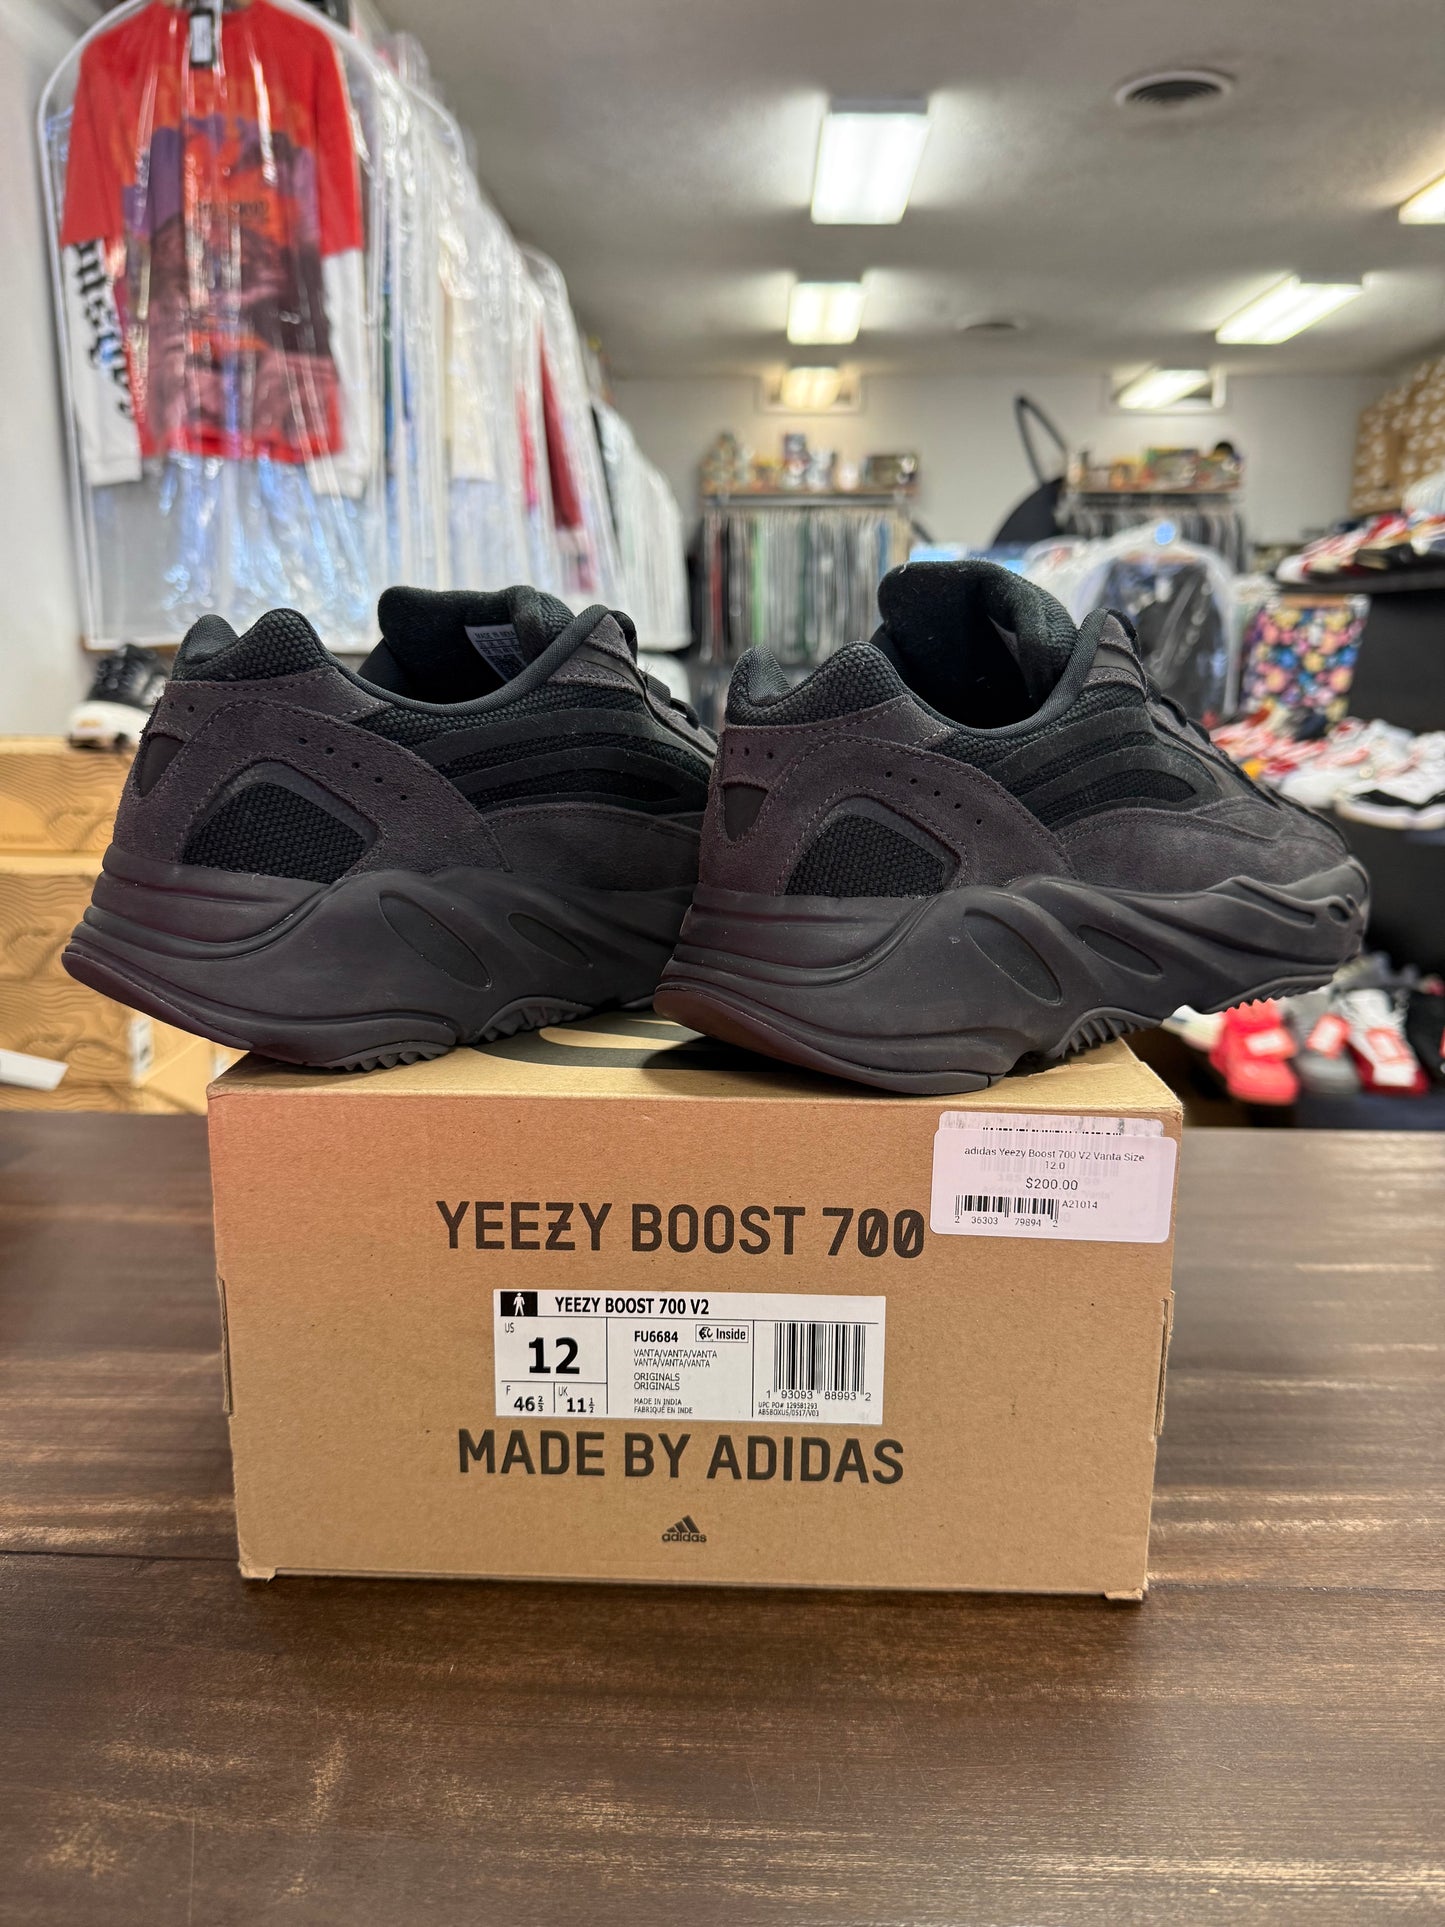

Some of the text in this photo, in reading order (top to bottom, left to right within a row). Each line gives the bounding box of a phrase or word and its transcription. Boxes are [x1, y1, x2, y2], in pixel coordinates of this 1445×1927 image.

[965, 1147, 1145, 1162] adidas Yeezy Boost 700 V2 Vanta Size
[1046, 1161, 1065, 1170] 12.0
[1026, 1177, 1079, 1191] $200.00
[1062, 1200, 1098, 1209] A21014
[955, 1216, 1058, 1228] 2 36303 79894 2
[632, 1203, 805, 1255] BOOST
[823, 1207, 925, 1259] 700
[555, 1296, 709, 1315] YEEZY BOOST 700 V2
[505, 1322, 515, 1334] US
[716, 1327, 746, 1341] Inside
[634, 1330, 679, 1343] FU6684
[528, 1336, 580, 1374] 12
[634, 1348, 717, 1359] VANTA/VANTA/VANTA
[634, 1358, 710, 1368] VANTA/VANTA/VANTA
[634, 1373, 680, 1382] ORIGINALS
[506, 1385, 511, 1396] F
[558, 1386, 569, 1397] UK
[634, 1382, 680, 1391] ORIGINALS
[634, 1398, 682, 1406] MADE IN INDIA
[765, 1390, 871, 1402] 1 93093 88993 2
[513, 1396, 535, 1412] 46
[567, 1397, 586, 1413] 11
[667, 1406, 676, 1414] EN
[677, 1406, 693, 1414] INDE
[459, 1428, 904, 1484] MADE BY ADIDAS
[662, 1532, 707, 1542] adidas
